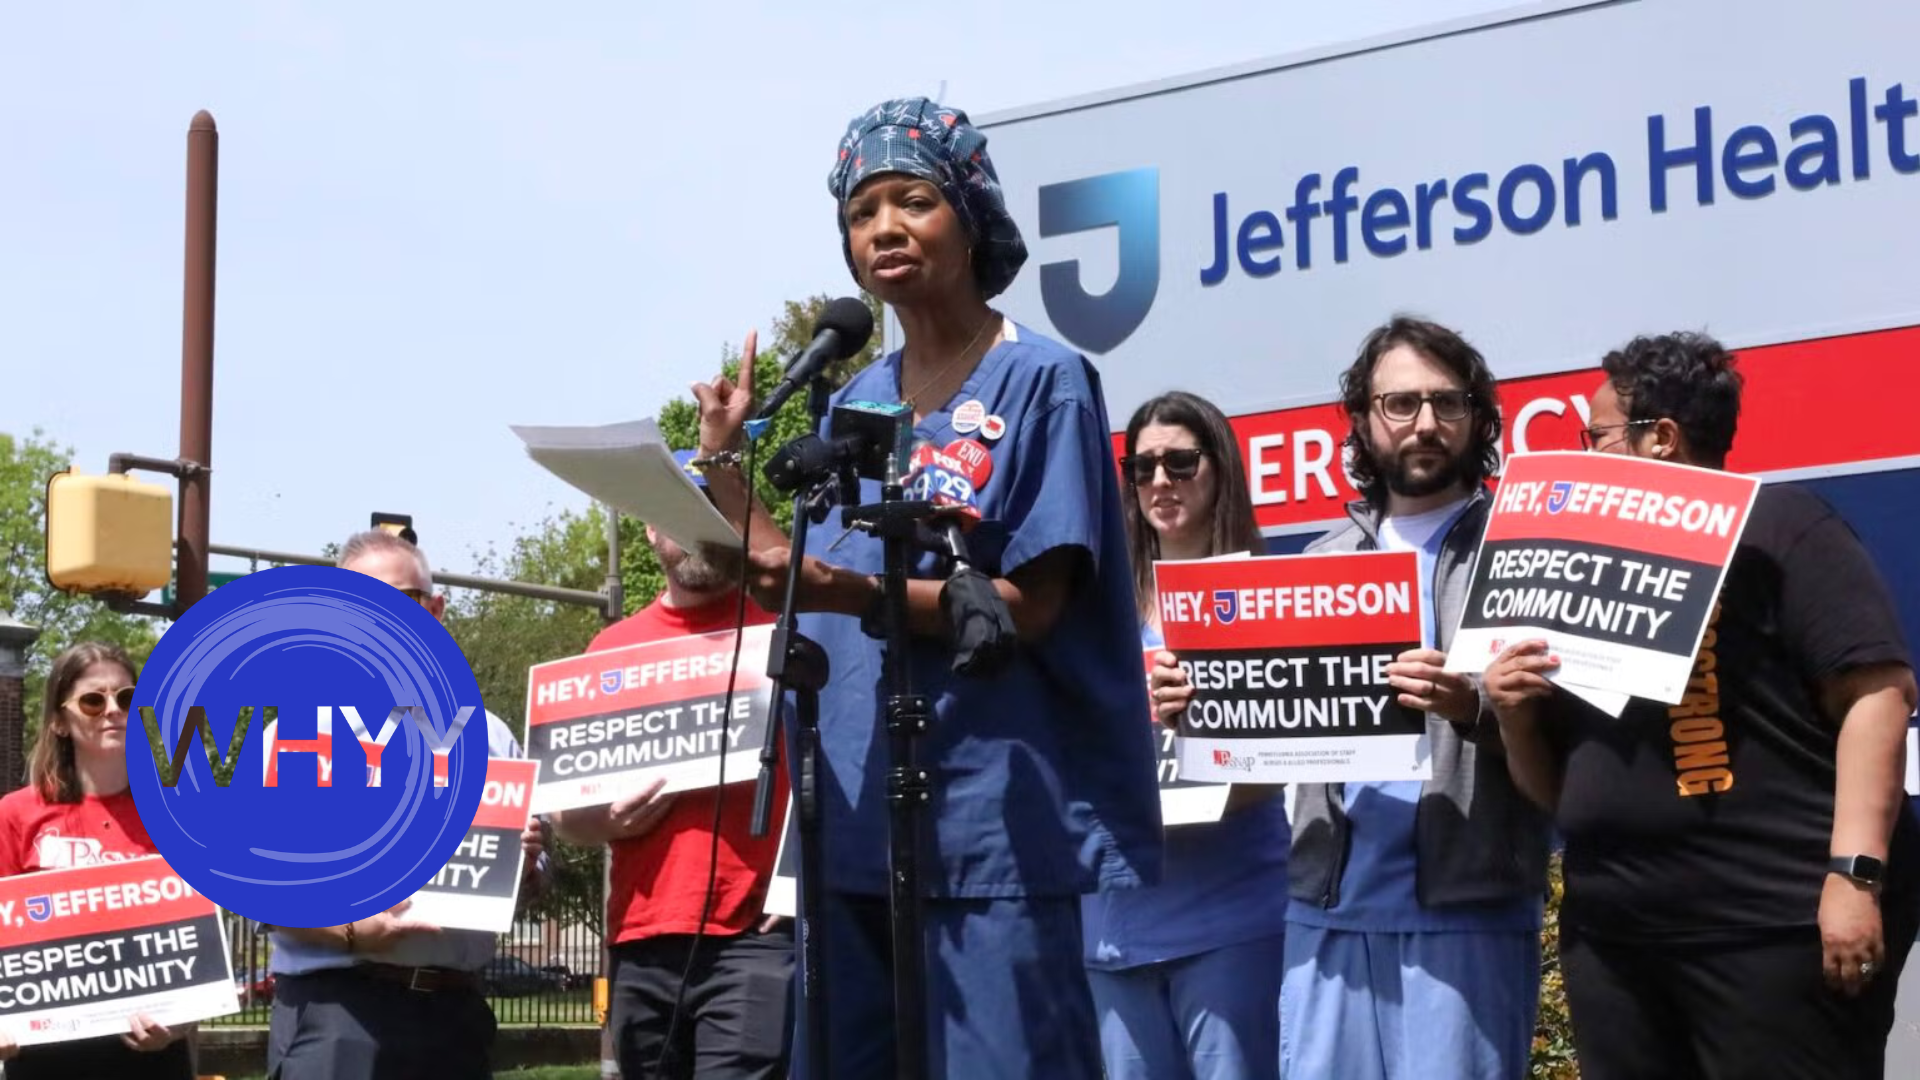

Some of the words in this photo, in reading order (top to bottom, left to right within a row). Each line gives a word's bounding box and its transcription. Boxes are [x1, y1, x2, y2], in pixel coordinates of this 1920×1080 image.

[1201, 151, 1619, 287] Jefferson
[934, 469, 972, 501] 29
[1498, 480, 1546, 517] HEY,
[1546, 480, 1737, 538] JEFFERSON
[1488, 548, 1613, 586] RESPECT
[1620, 559, 1692, 601] THE
[1160, 590, 1211, 628] HEY,
[1212, 581, 1411, 626] JEFFERSON
[1481, 587, 1673, 640] COMMUNITY
[537, 674, 597, 707] HEY,
[1179, 655, 1310, 691] RESPECT
[1319, 654, 1393, 687] THE
[550, 707, 683, 750] RESPECT
[690, 696, 751, 726] THE
[1187, 695, 1390, 730] COMMUNITY
[552, 724, 746, 776] COMMUNITY
[0, 937, 125, 980] ESPECT
[133, 925, 199, 957] THE
[0, 955, 197, 1009] COMMUNITY
